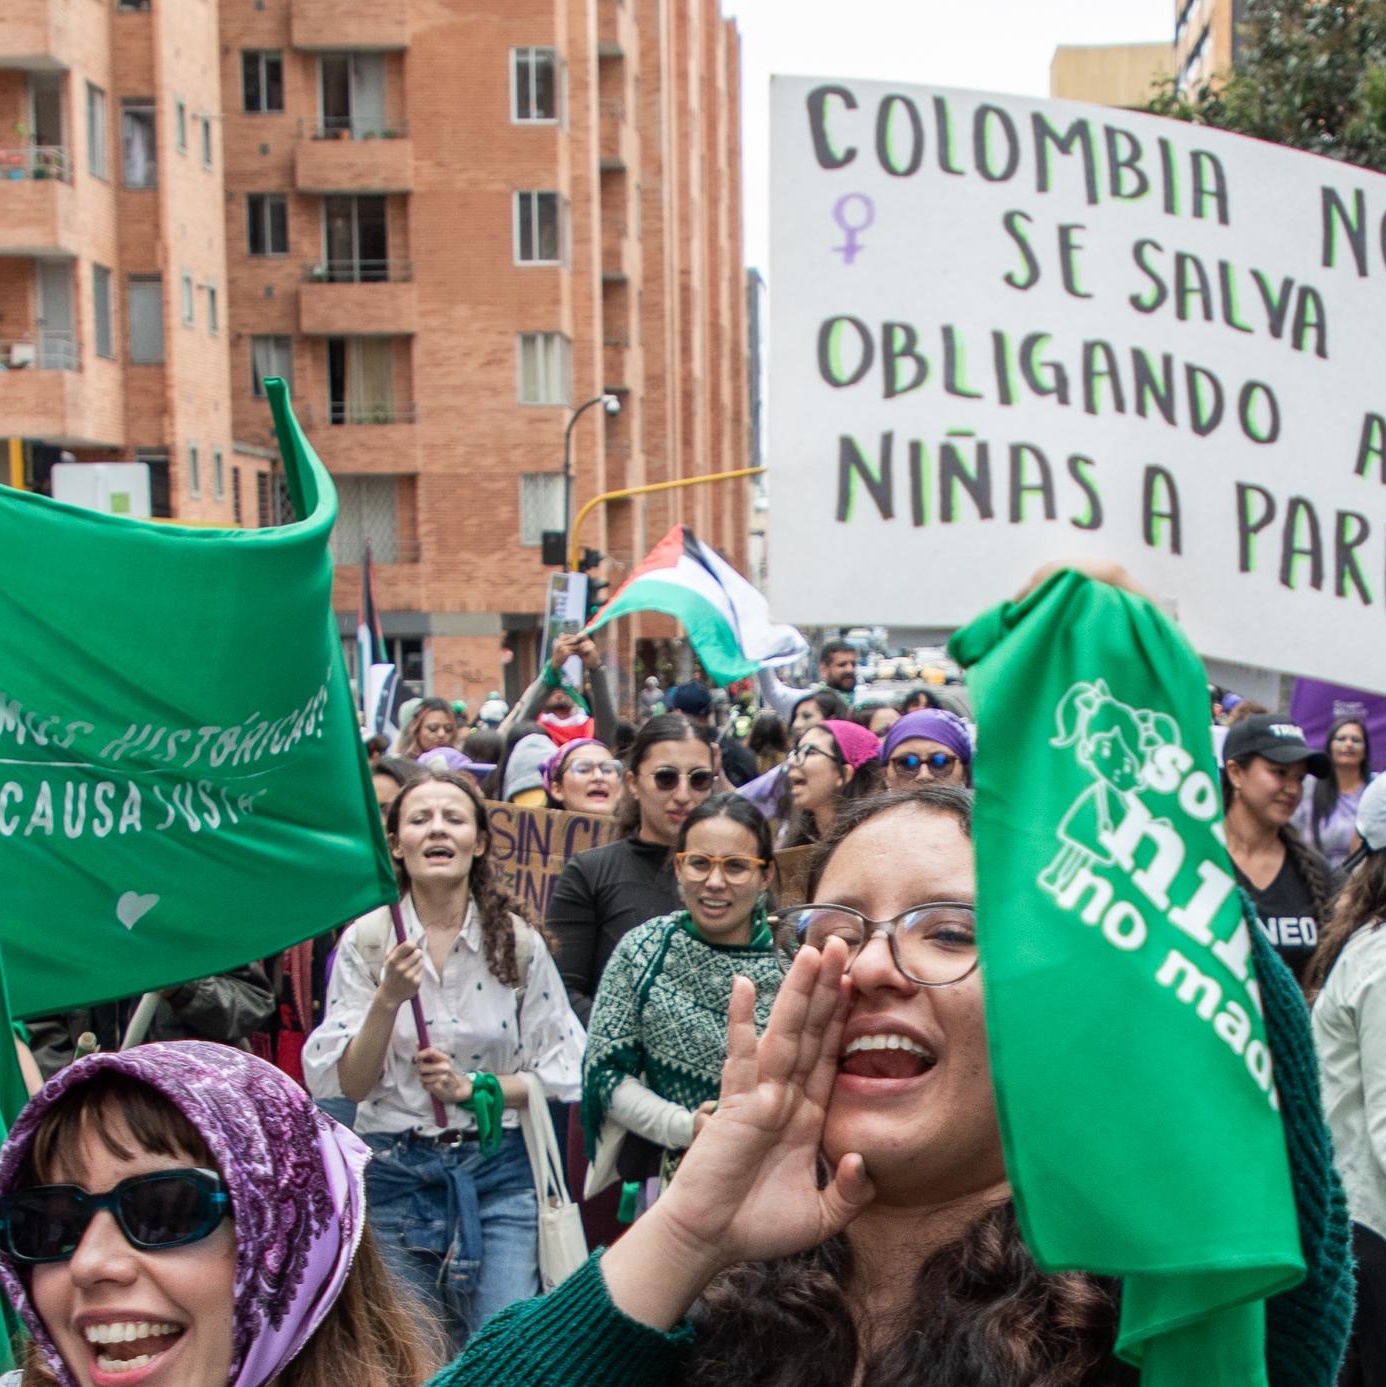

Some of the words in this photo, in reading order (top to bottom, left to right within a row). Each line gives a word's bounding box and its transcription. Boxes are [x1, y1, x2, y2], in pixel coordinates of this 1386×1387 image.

[805, 84, 1231, 226] COLOMBIA
[1002, 209, 1094, 299] SE
[1128, 238, 1329, 361] SALVA
[816, 313, 1282, 445] OBLIGANDO
[834, 427, 1104, 532] NIÑAS
[1142, 462, 1183, 556] A
[488, 807, 554, 868] SIN
[1144, 743, 1229, 850] so
[1055, 867, 1148, 951] no
